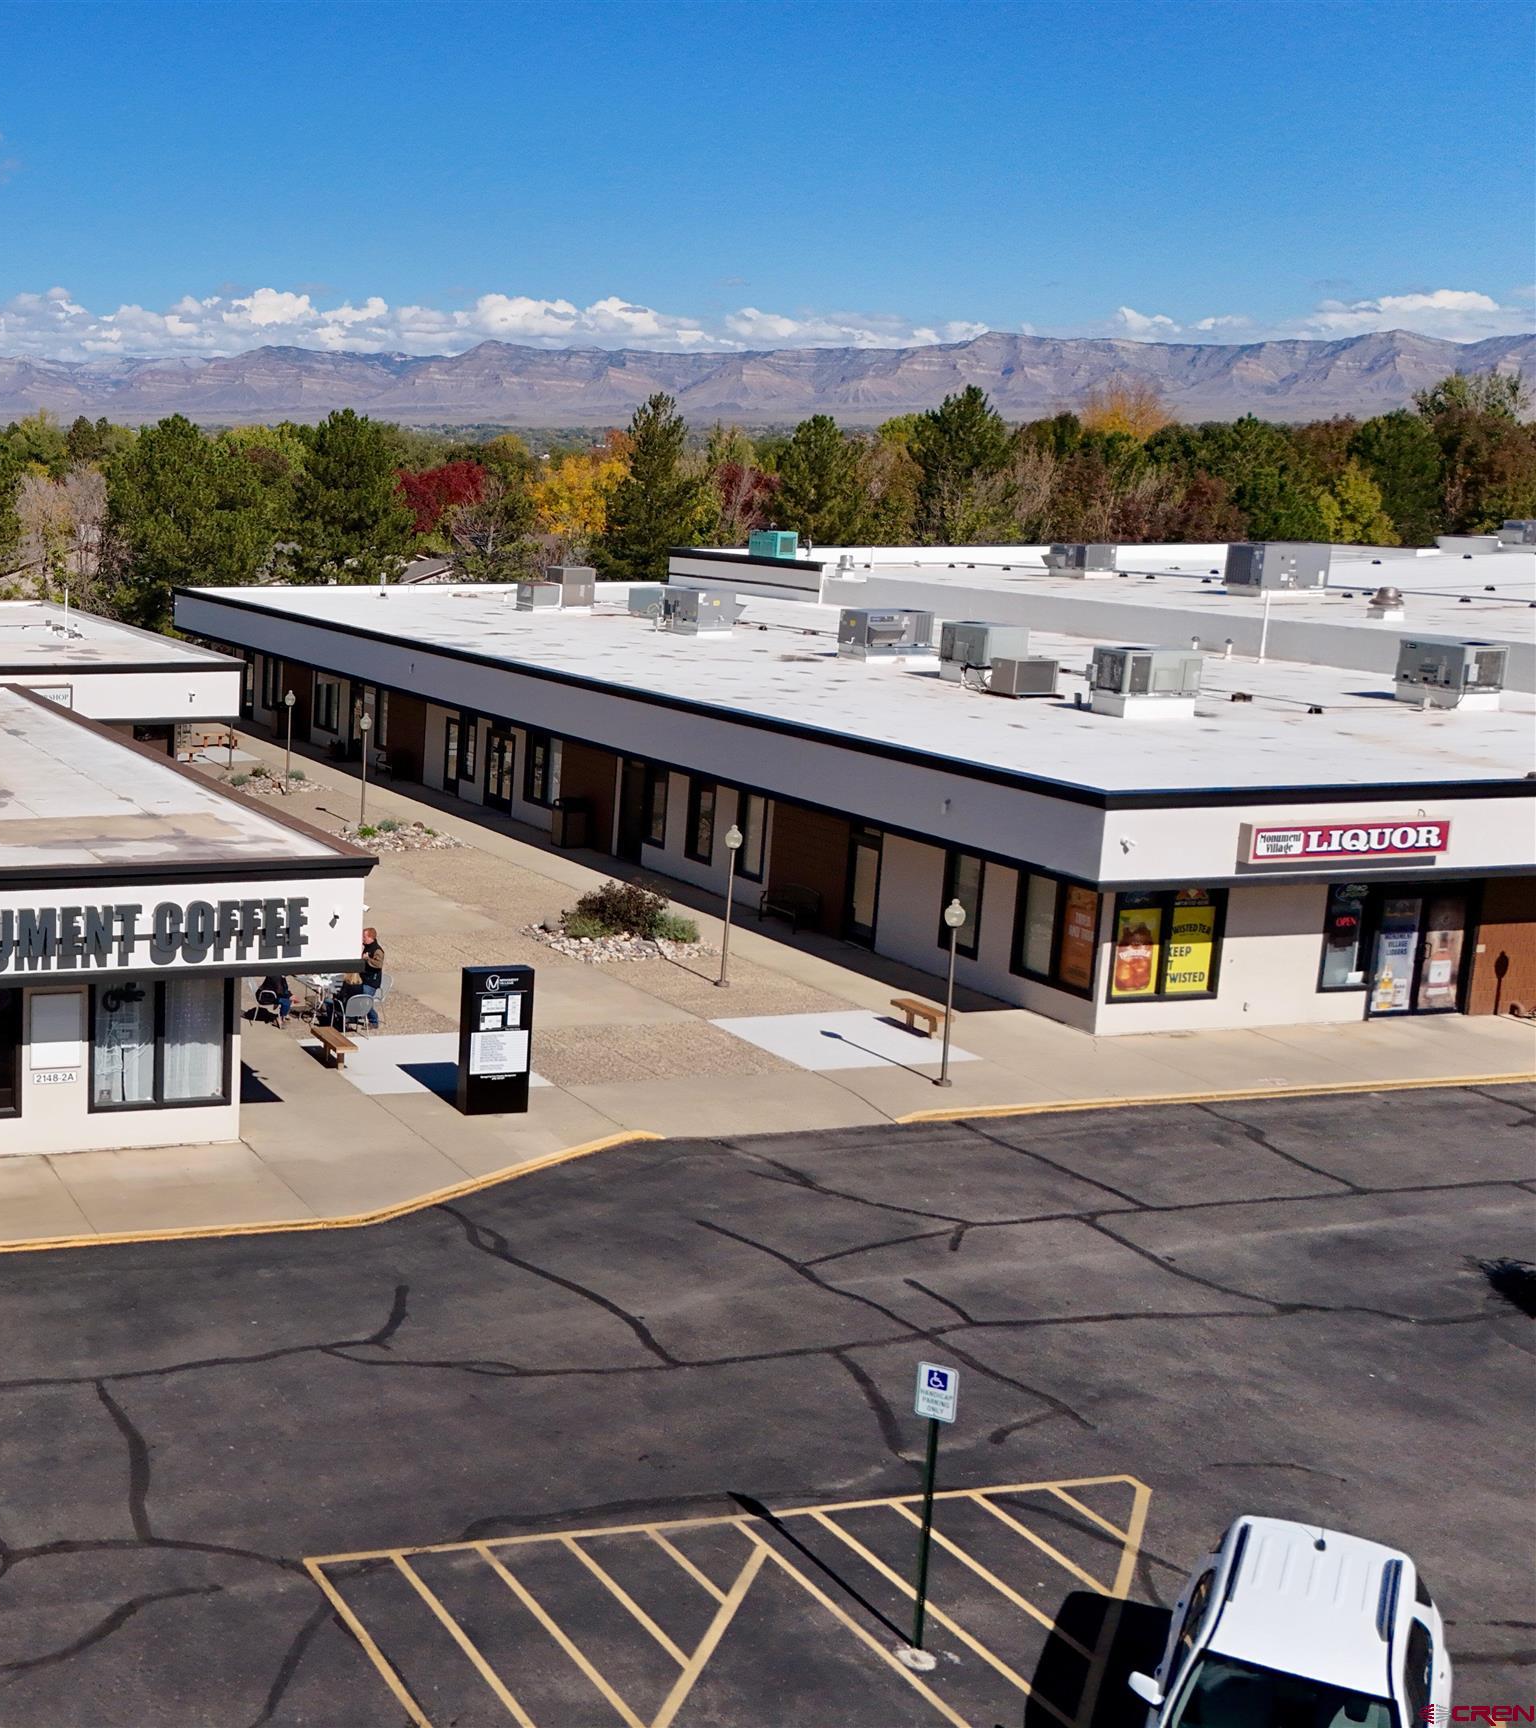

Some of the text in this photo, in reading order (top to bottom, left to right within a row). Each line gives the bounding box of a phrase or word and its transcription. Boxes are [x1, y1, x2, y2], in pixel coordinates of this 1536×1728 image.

[1260, 832, 1302, 844] Monument
[1306, 825, 1442, 853] LIQUOR
[1266, 843, 1294, 855] Village
[152, 897, 310, 952] COFFEE
[36, 1073, 74, 1083] 2148-2A
